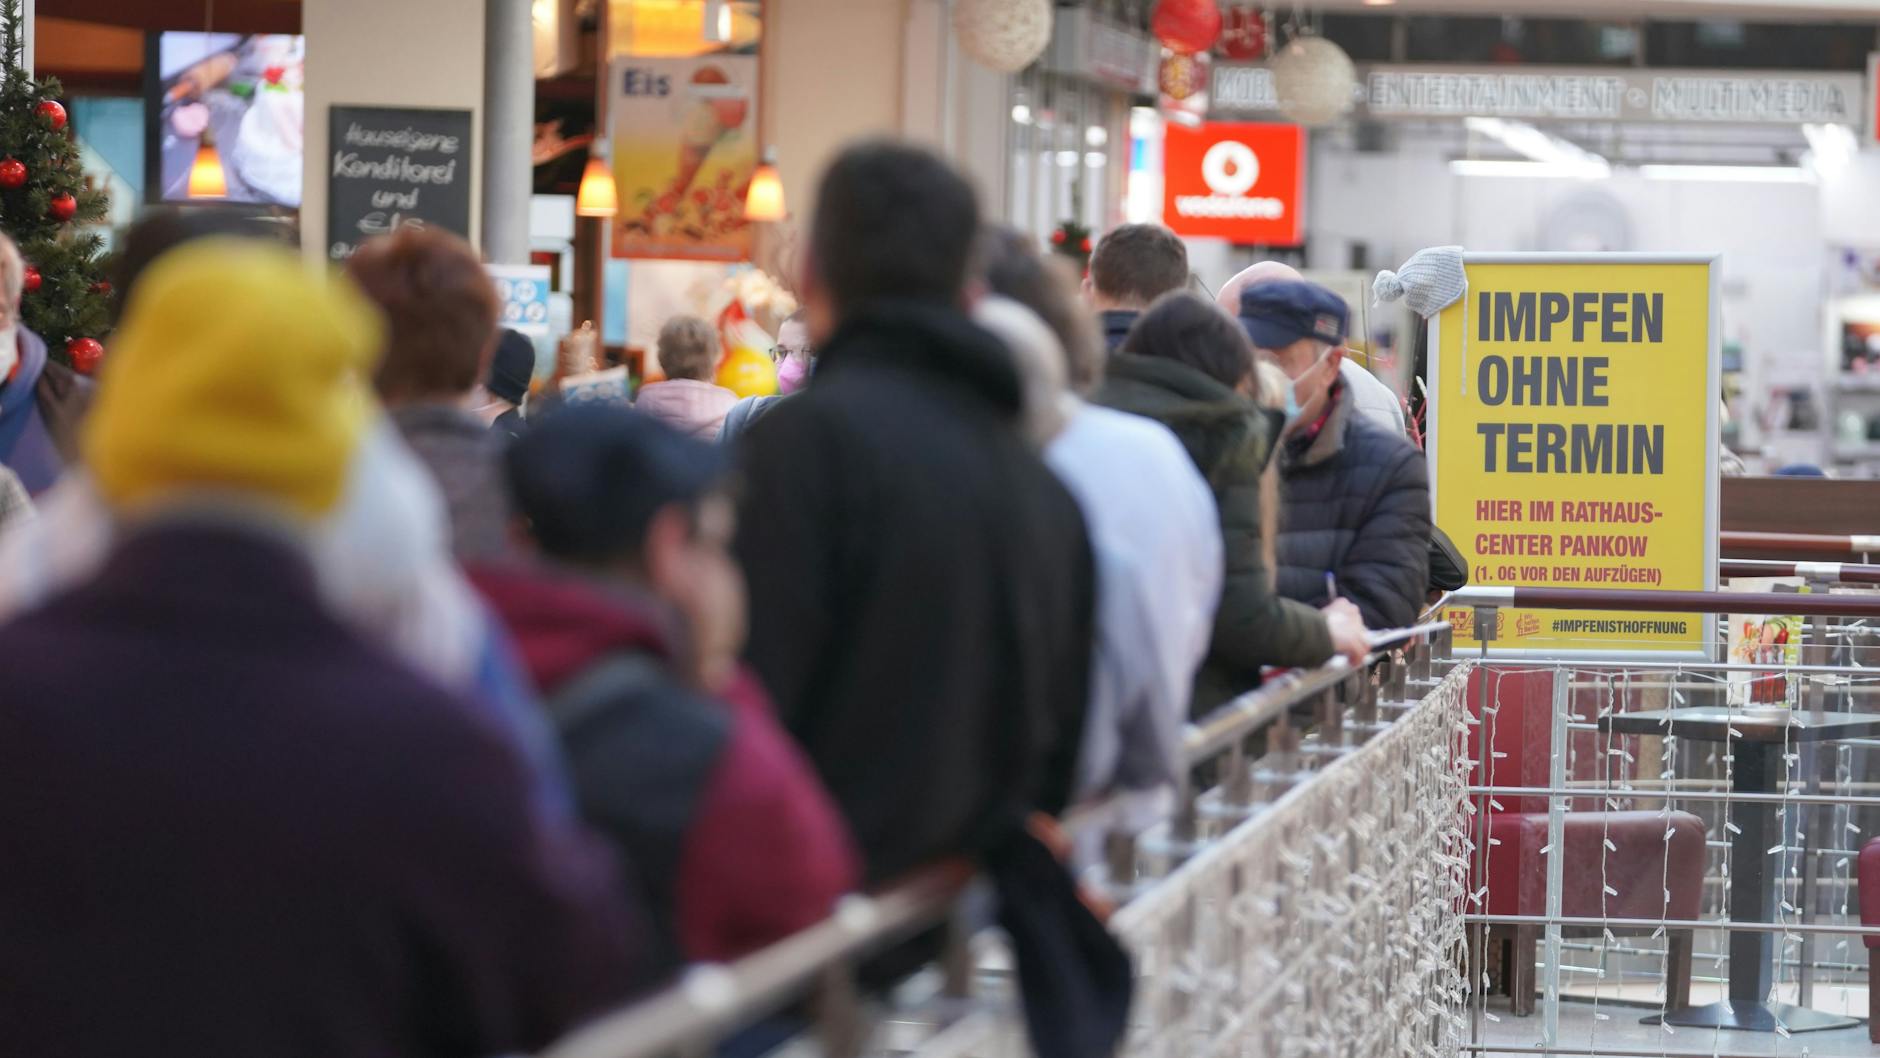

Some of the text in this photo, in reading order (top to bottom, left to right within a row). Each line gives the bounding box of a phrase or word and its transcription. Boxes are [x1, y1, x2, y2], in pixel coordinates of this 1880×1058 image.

[623, 67, 671, 96] Eis
[1367, 73, 1623, 116] ENTERTAINMENT
[1652, 77, 1847, 121] MULTIMEDIA
[333, 150, 457, 184] Konditorei
[371, 187, 420, 210] und
[1175, 195, 1284, 219] vodafone
[1478, 291, 1664, 343] IMPFEN
[1477, 354, 1609, 407] OHNE
[1476, 422, 1664, 475] TERMIN
[1476, 500, 1663, 524] HIER IM RATHAUS-
[1475, 534, 1648, 557] CENTER PANKOW
[1475, 564, 1662, 586] (1. OG VOR DEN AUFZÜGEN)
[1552, 619, 1687, 635] #IMPFENISTHOFFNUNG
